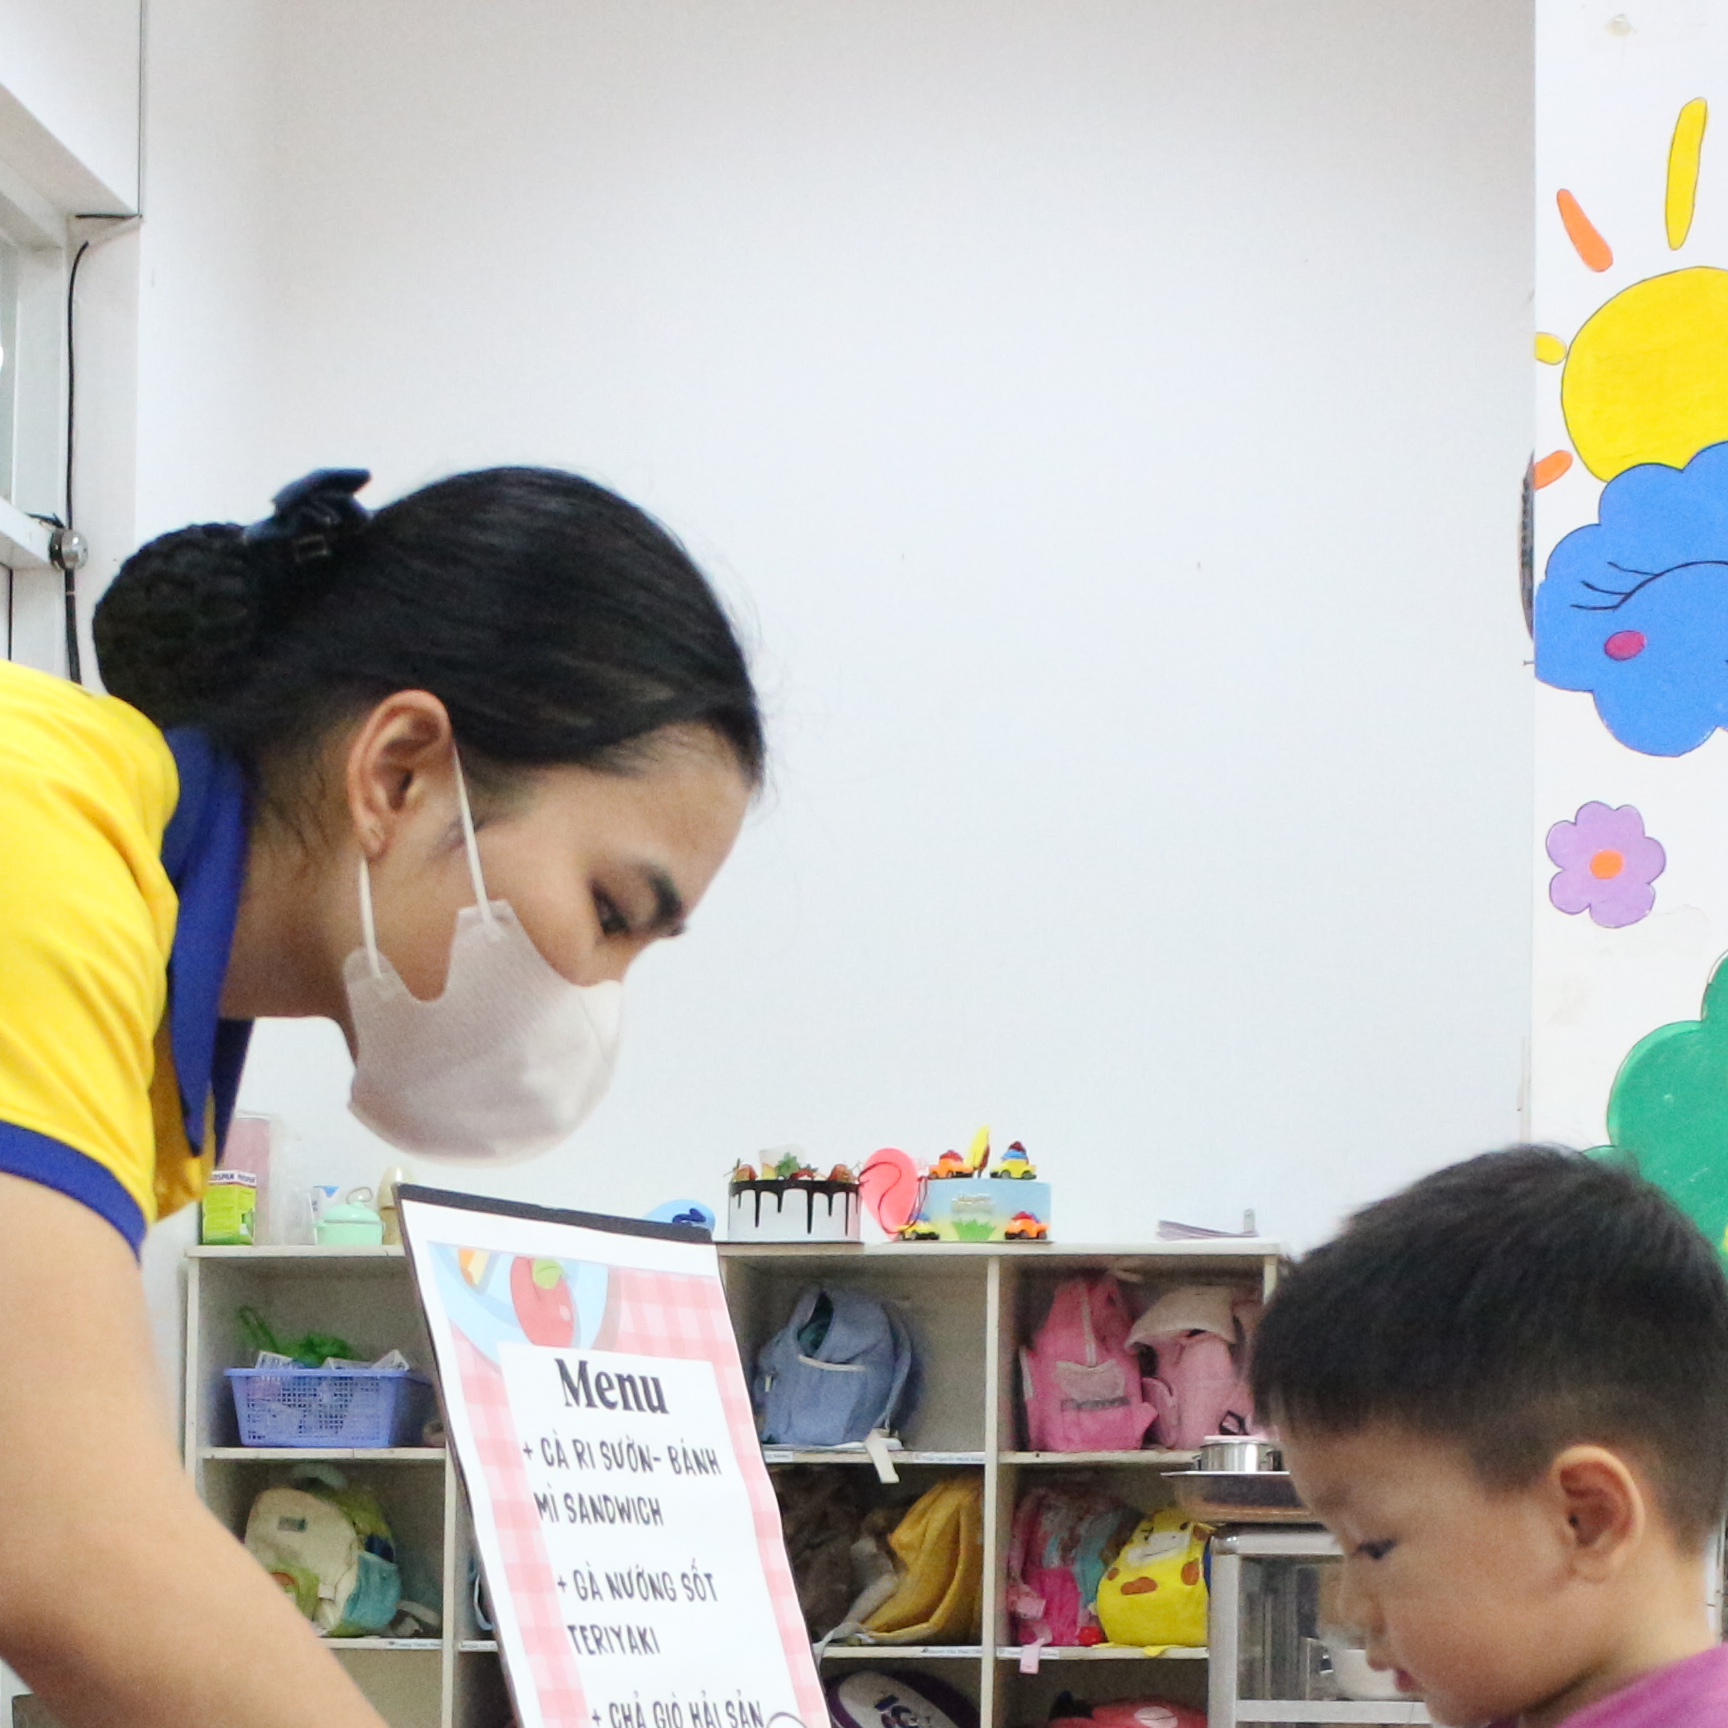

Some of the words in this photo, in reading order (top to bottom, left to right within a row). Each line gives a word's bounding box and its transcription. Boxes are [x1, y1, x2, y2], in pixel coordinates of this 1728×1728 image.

[554, 1357, 670, 1415] Menu
[540, 1429, 570, 1470] CÀ
[572, 1438, 596, 1470] RI
[666, 1437, 722, 1476] BÁNH
[533, 1482, 559, 1523] MÌ
[563, 1492, 664, 1527] SANDWICH
[572, 1560, 604, 1602] GÀ
[680, 1557, 719, 1602] SỐT
[567, 1624, 661, 1656] TERIYAKI
